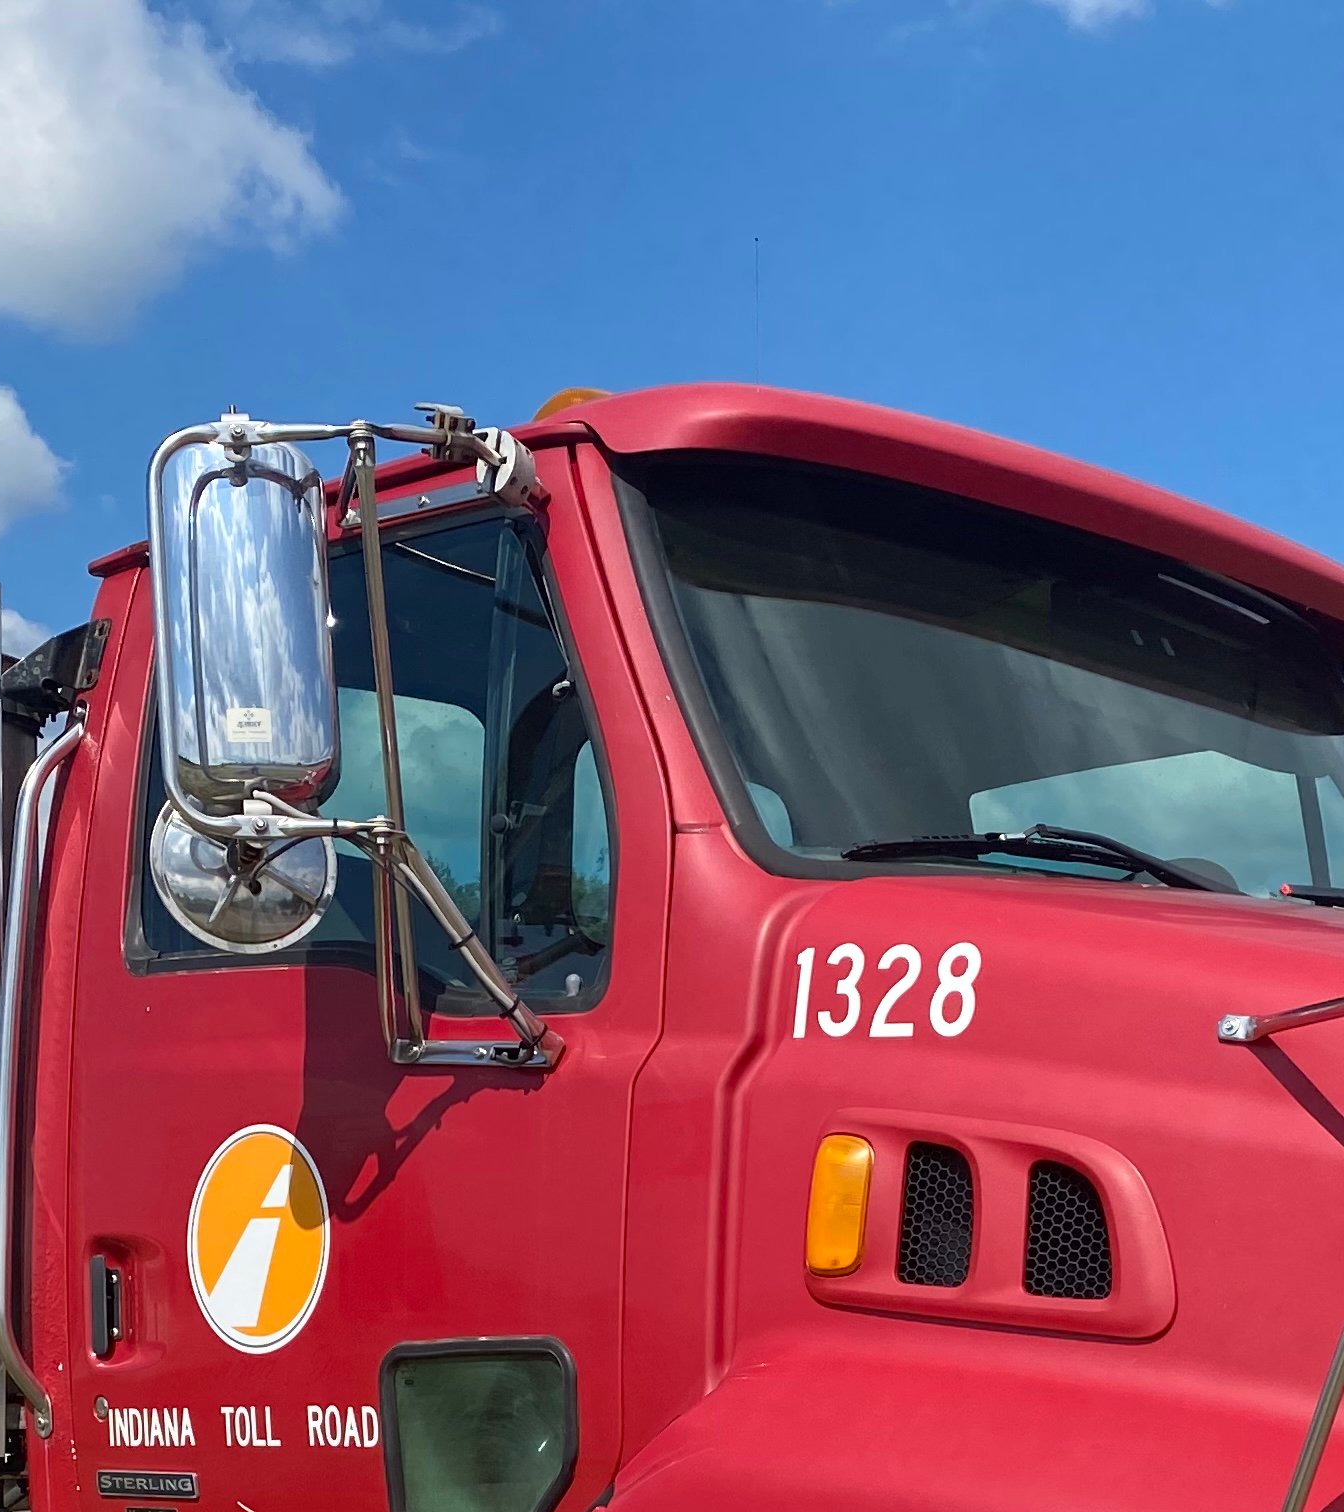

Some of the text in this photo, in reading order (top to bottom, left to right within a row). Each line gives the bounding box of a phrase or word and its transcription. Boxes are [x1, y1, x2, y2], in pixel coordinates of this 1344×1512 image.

[792, 940, 983, 1040] 1328
[108, 1404, 380, 1449] INDIANA TOLL ROAD
[99, 1474, 194, 1493] STERLING
